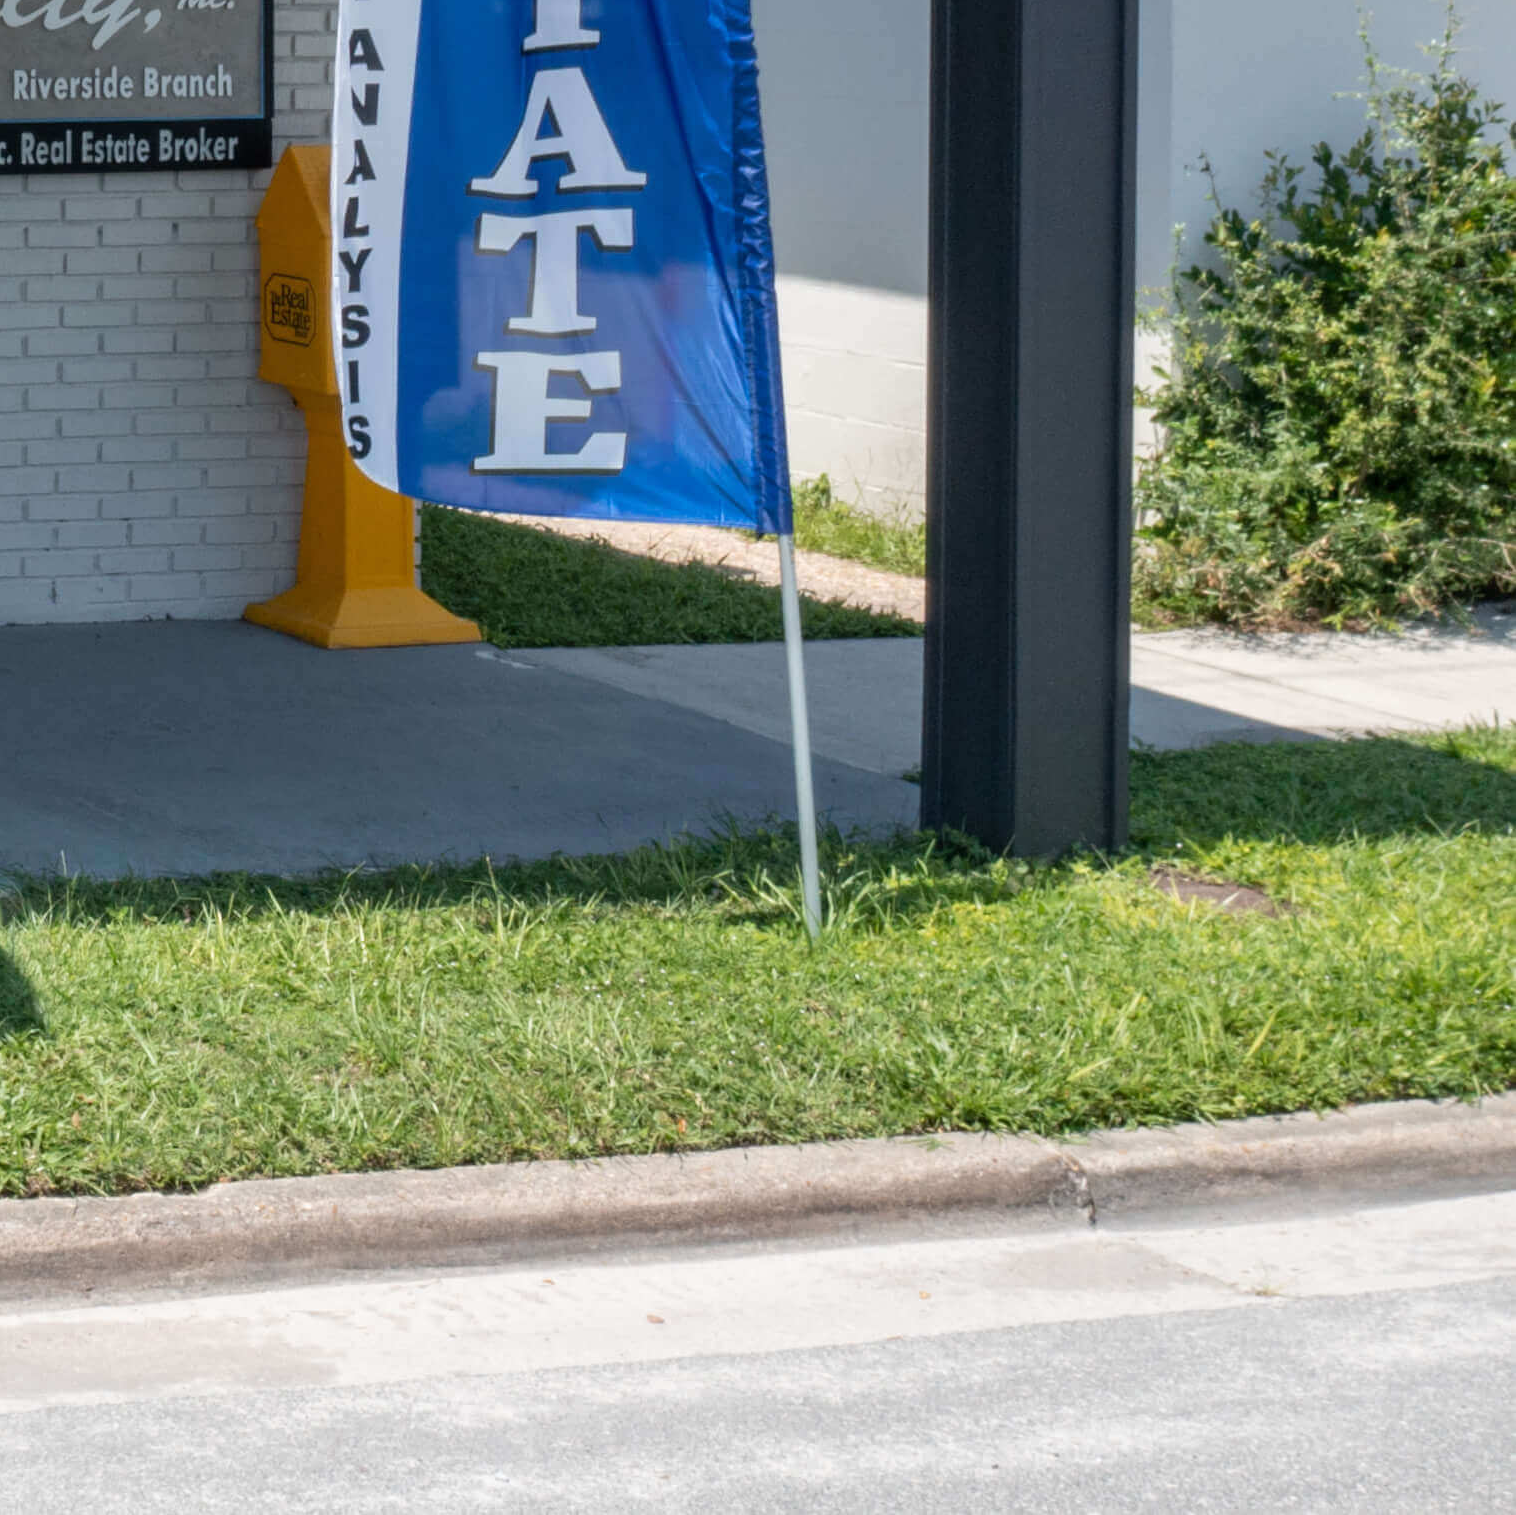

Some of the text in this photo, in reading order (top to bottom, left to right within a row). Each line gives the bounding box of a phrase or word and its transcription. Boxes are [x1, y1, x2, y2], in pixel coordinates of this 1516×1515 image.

[13, 64, 233, 101] Riverside Branch
[20, 132, 73, 166] Real
[81, 130, 150, 164] Estate
[159, 127, 239, 163] Broker
[339, 29, 387, 461] ANALYSIS
[281, 283, 309, 311] Real
[270, 301, 311, 331] Estate
